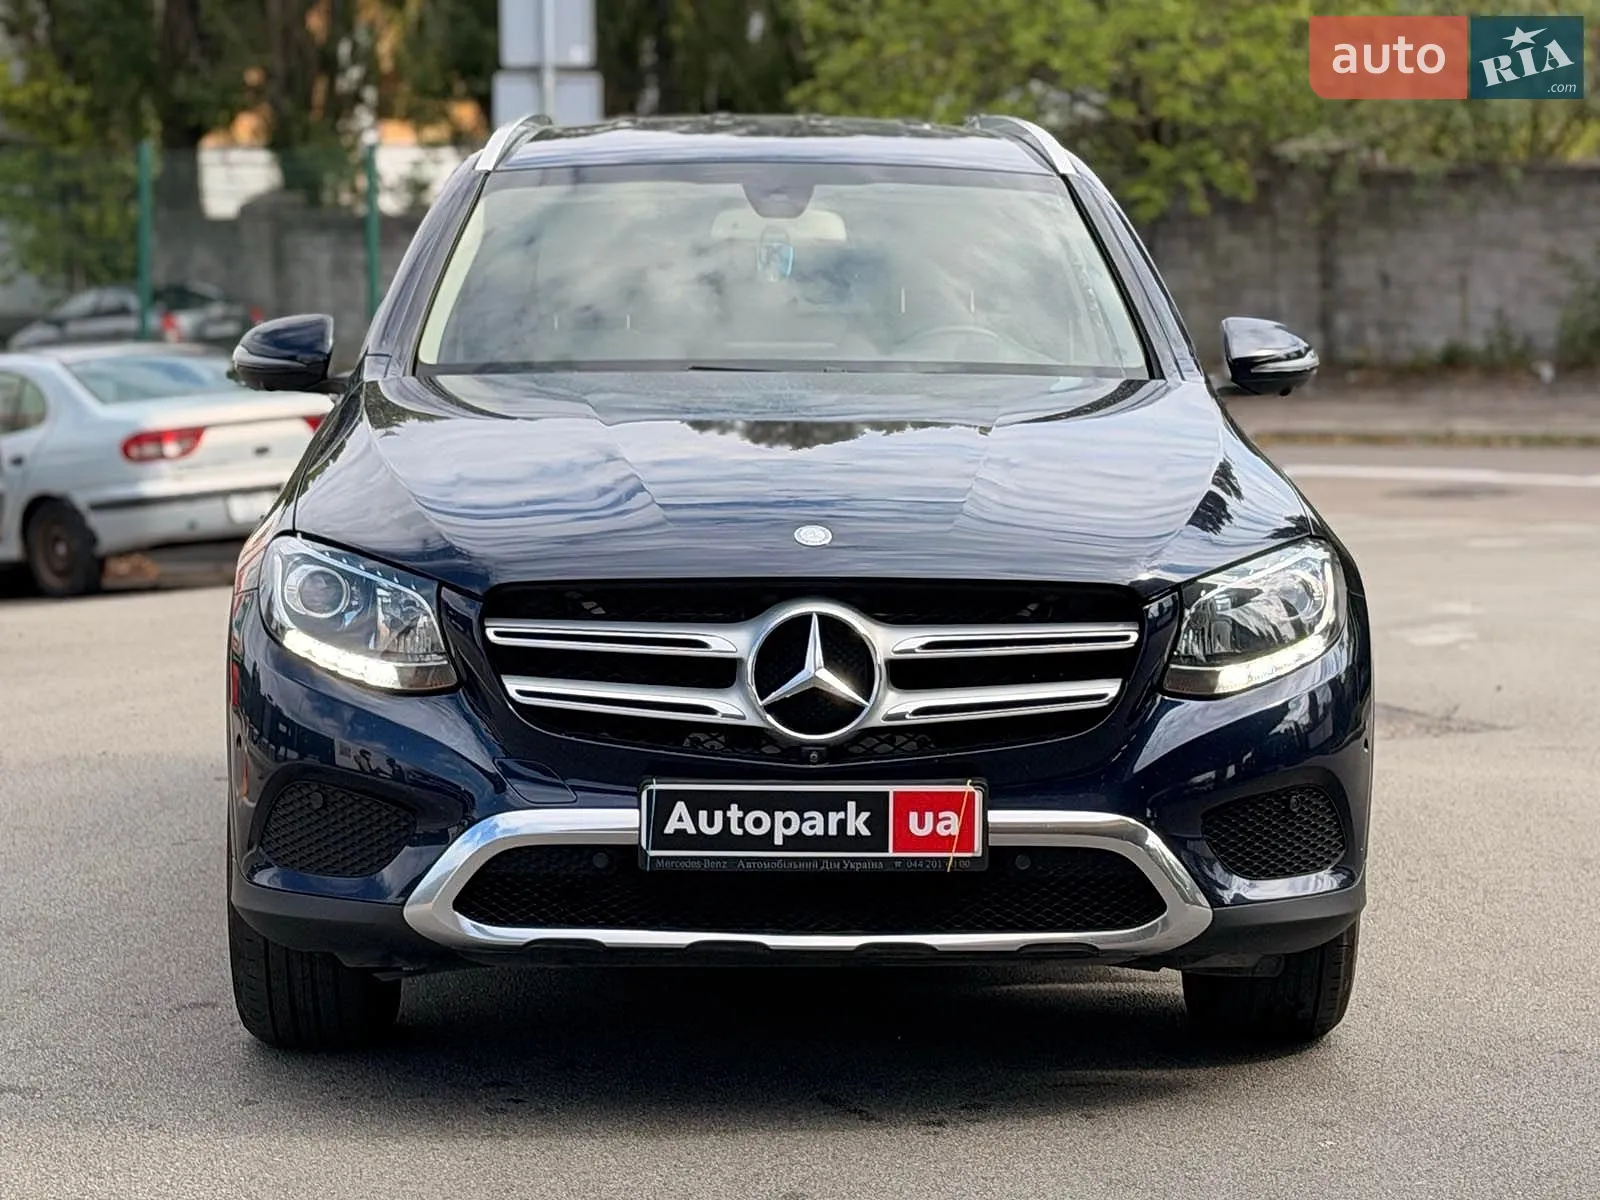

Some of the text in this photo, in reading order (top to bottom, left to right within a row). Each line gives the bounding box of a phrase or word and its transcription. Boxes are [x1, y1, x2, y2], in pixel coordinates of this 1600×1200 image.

[663, 801, 960, 845] Autopark ua
[656, 859, 727, 869] Mercedes-Benz
